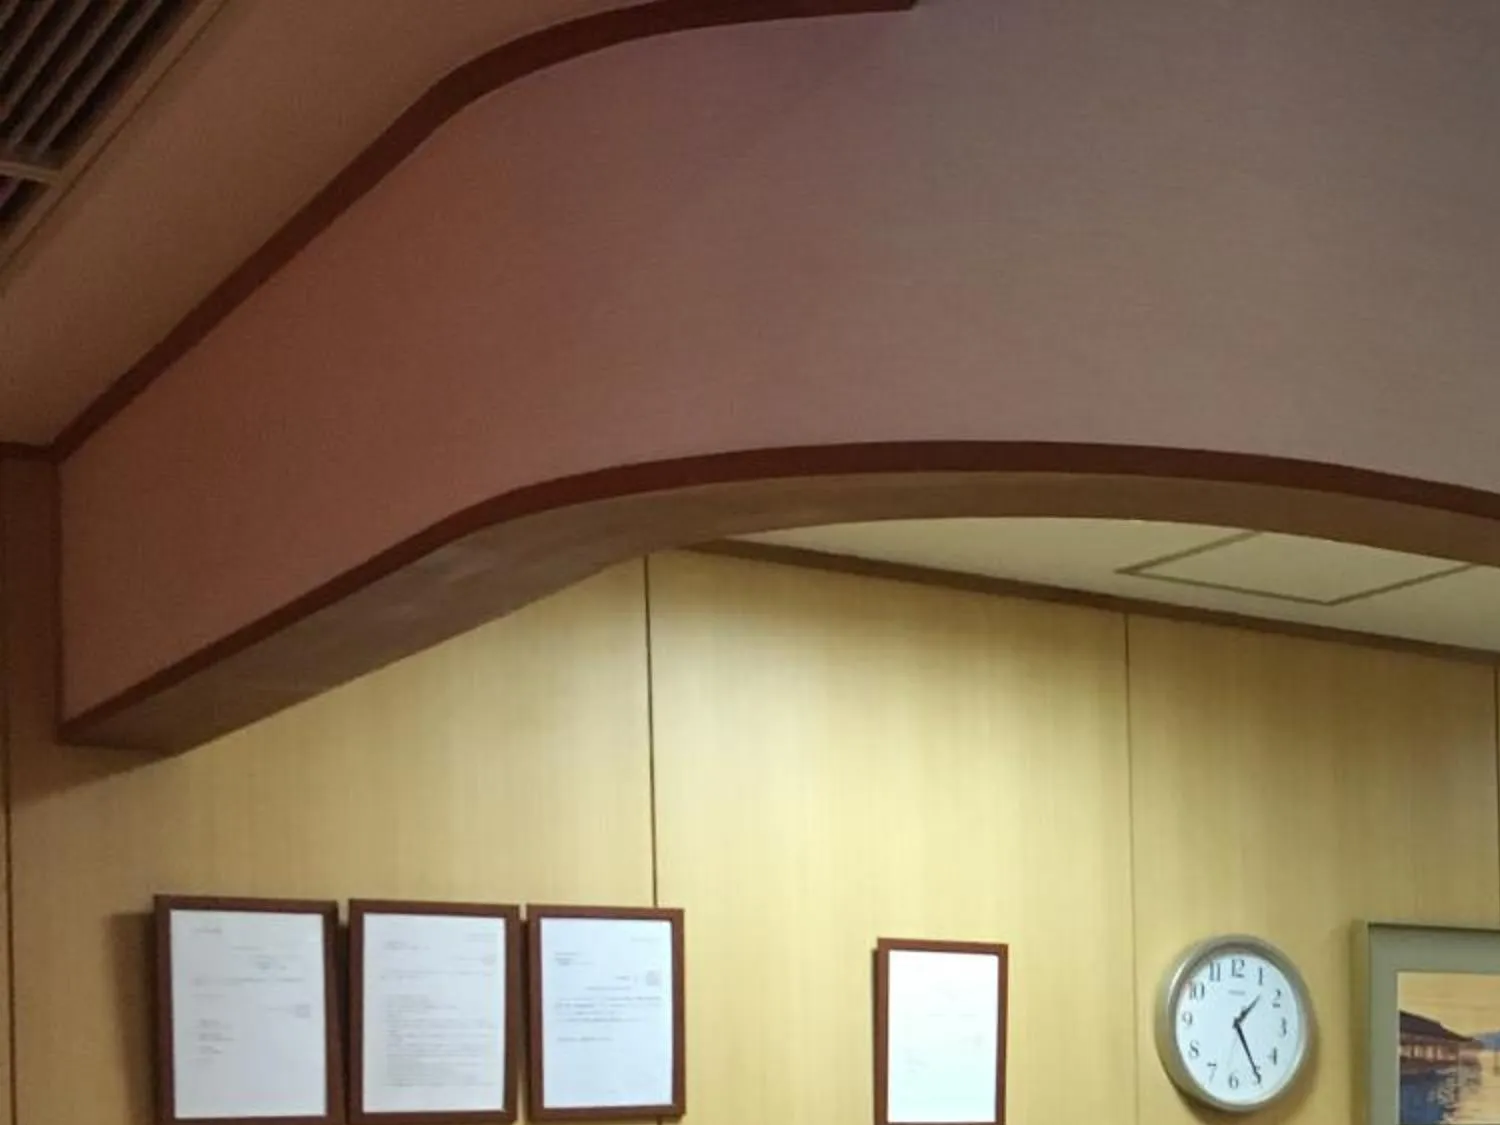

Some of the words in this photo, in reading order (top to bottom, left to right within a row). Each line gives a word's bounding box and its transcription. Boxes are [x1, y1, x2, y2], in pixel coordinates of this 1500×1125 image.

[1209, 962, 1221, 982] 11
[1231, 958, 1245, 978] 12
[1257, 966, 1264, 986] 1
[1190, 981, 1206, 1000] 10
[1272, 988, 1283, 1009] 2
[1182, 1011, 1194, 1030] 9
[1279, 1016, 1288, 1037] 3
[1188, 1038, 1200, 1060] 8
[1266, 1046, 1279, 1067] 4
[1207, 1061, 1218, 1083] 7
[1228, 1072, 1240, 1090] 6
